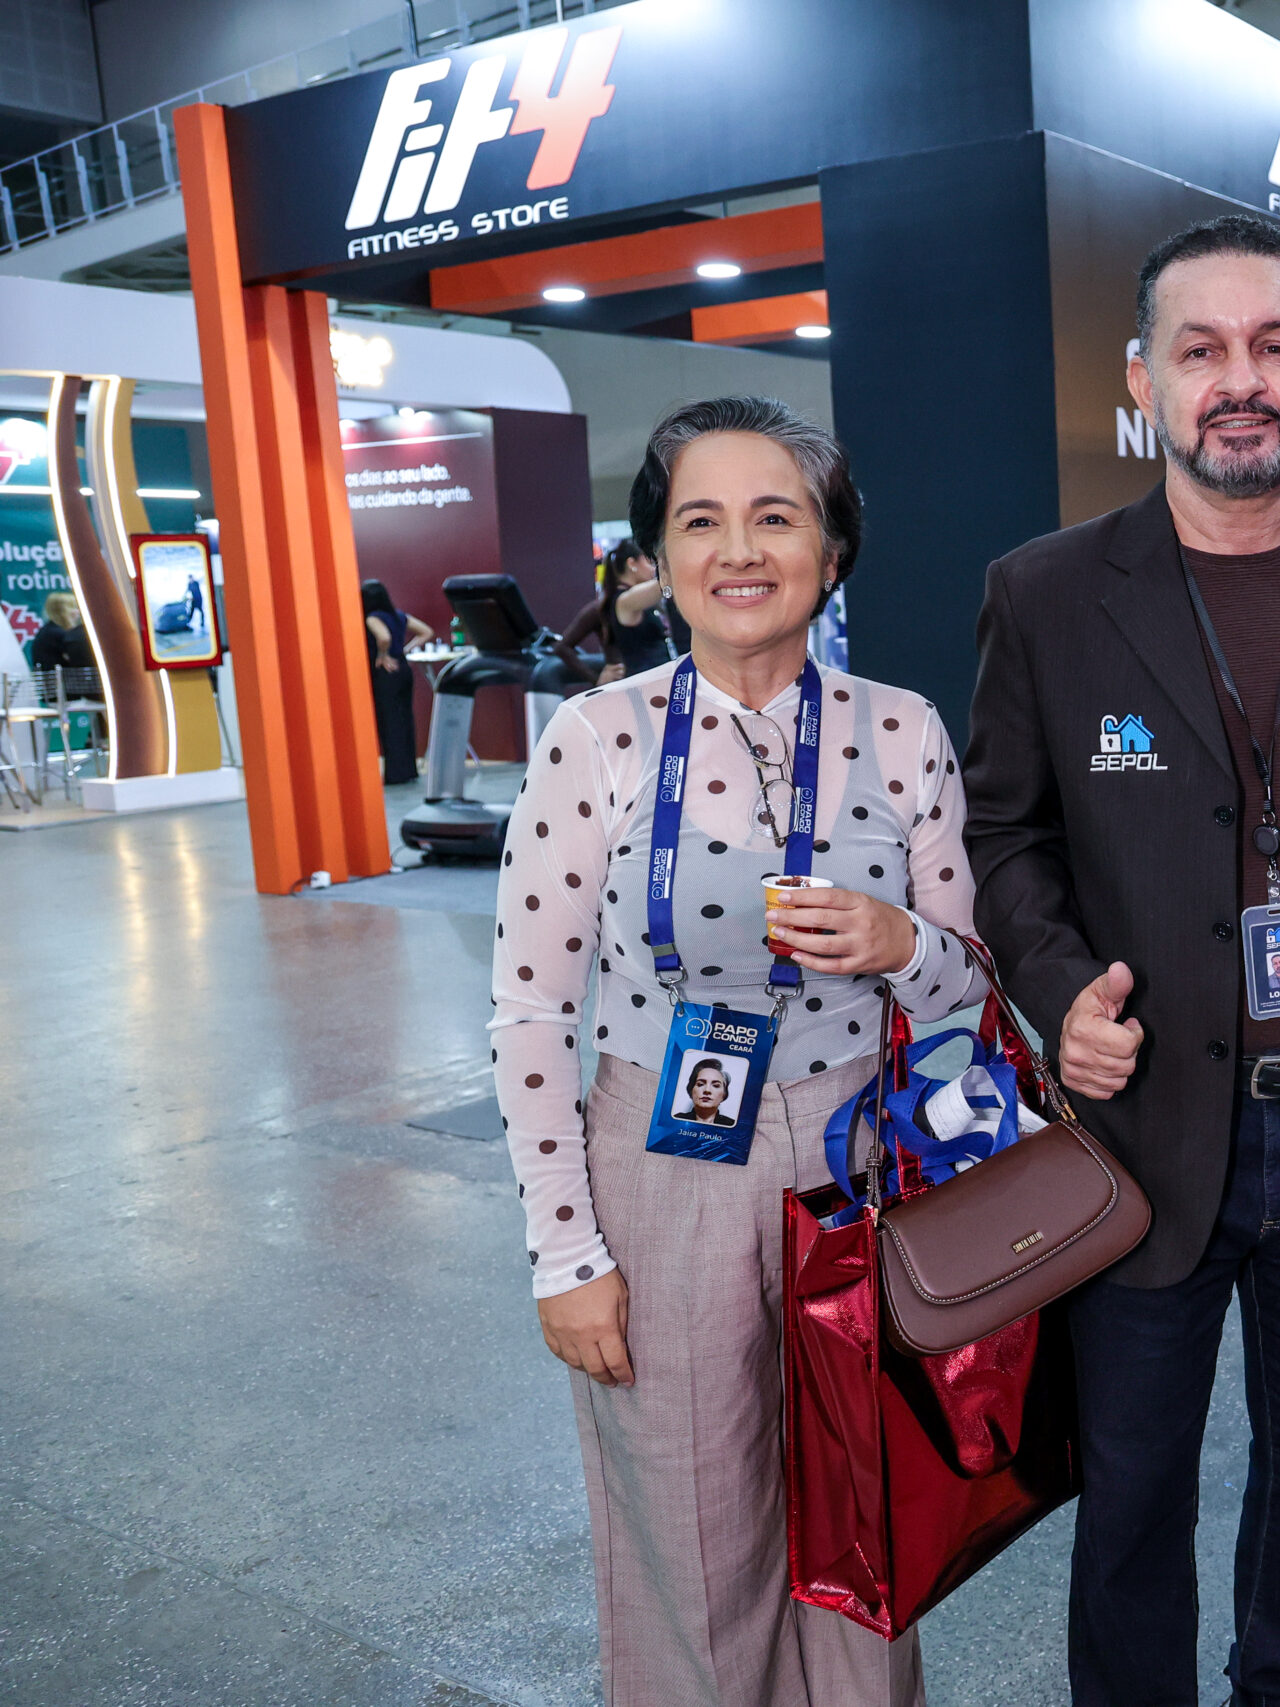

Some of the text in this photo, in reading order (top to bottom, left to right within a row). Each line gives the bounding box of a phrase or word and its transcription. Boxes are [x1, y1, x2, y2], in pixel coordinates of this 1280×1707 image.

[383, 469, 398, 485] ao
[398, 468, 421, 484] seu
[418, 487, 434, 505] da
[0, 541, 63, 568] luçã
[673, 673, 683, 700] PAPO
[679, 673, 688, 700] CONDO
[810, 718, 818, 747] PAPO
[663, 755, 673, 785] PAPO
[669, 755, 678, 786] CONDO
[1089, 752, 1169, 772] SEPOL
[804, 804, 813, 834] PAPO
[652, 848, 662, 882] PAPO
[659, 848, 667, 881] CONDO
[712, 1031, 757, 1046] CONDO
[713, 1022, 758, 1038] PAPO
[729, 1044, 753, 1053] CEARÁ
[699, 1131, 723, 1141] Paulo
